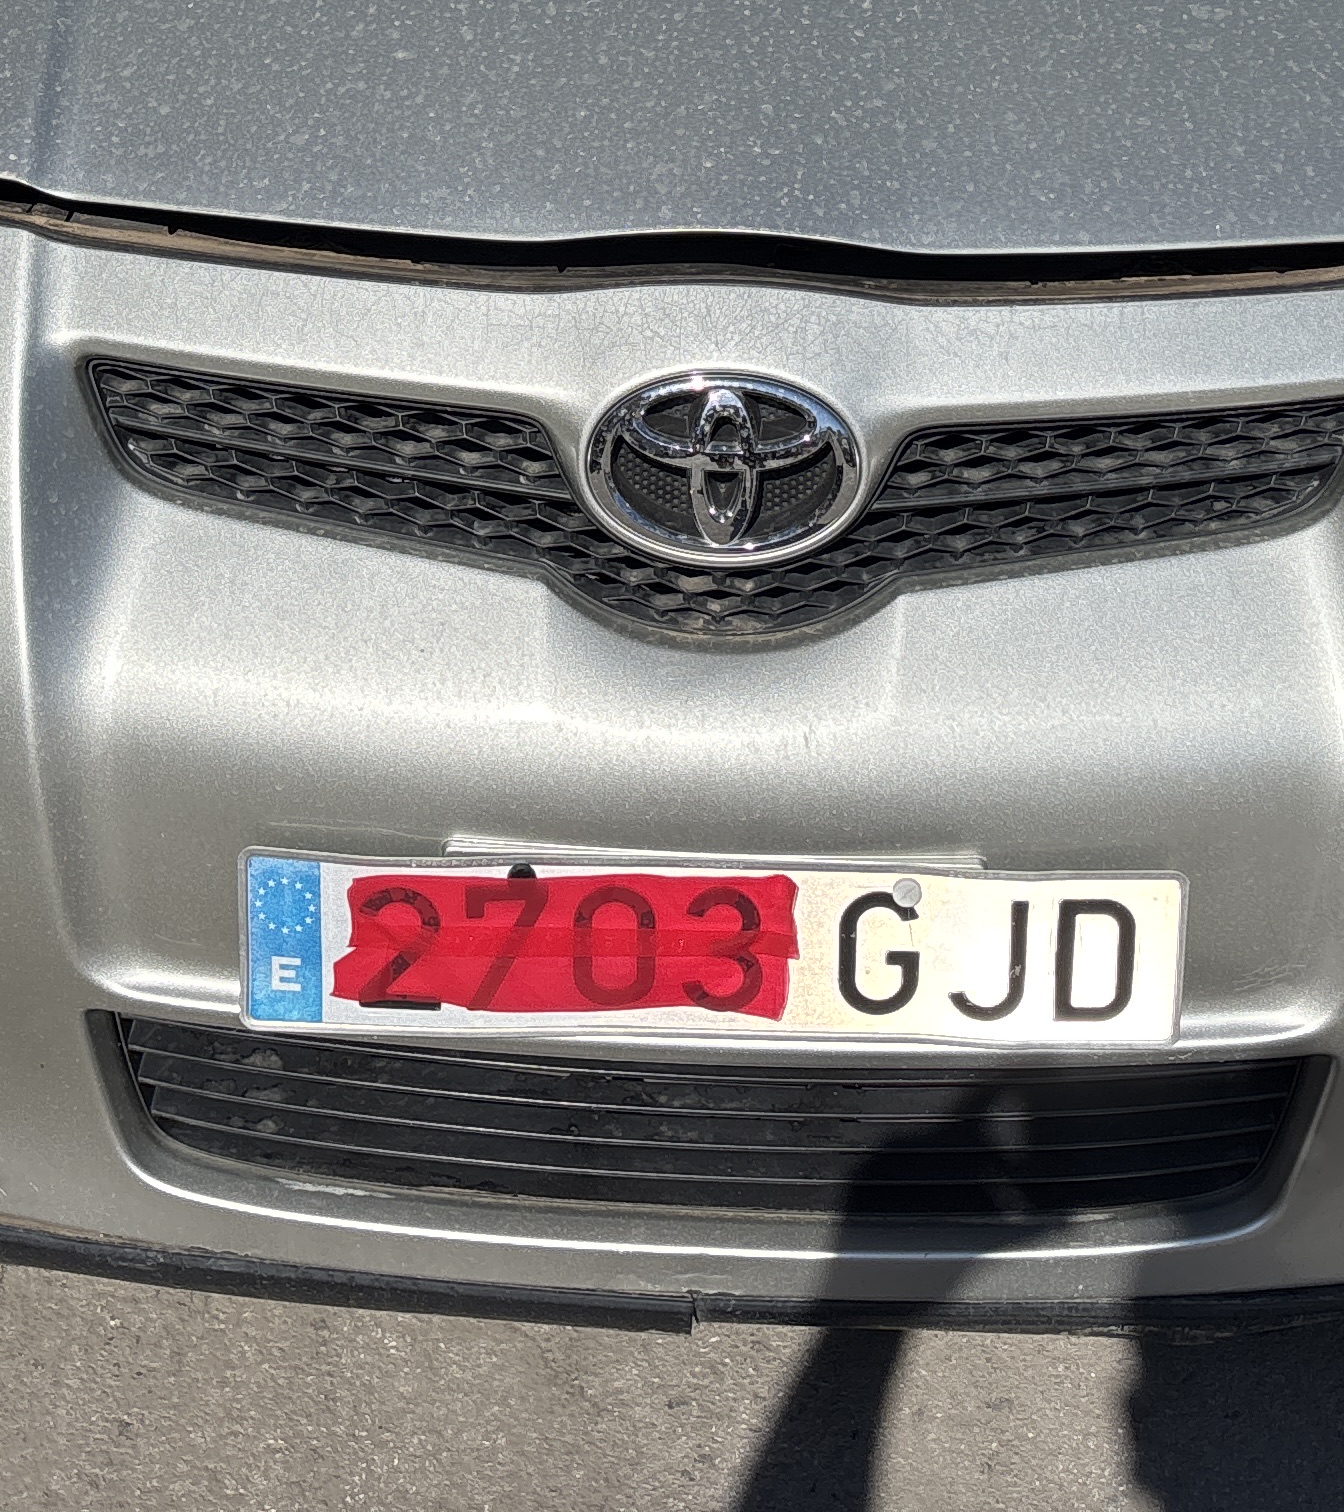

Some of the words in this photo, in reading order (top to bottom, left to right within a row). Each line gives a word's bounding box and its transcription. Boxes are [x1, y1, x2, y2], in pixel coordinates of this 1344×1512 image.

[271, 955, 302, 992] E
[359, 884, 763, 1011] 2703
[837, 891, 1136, 1021] GJD
